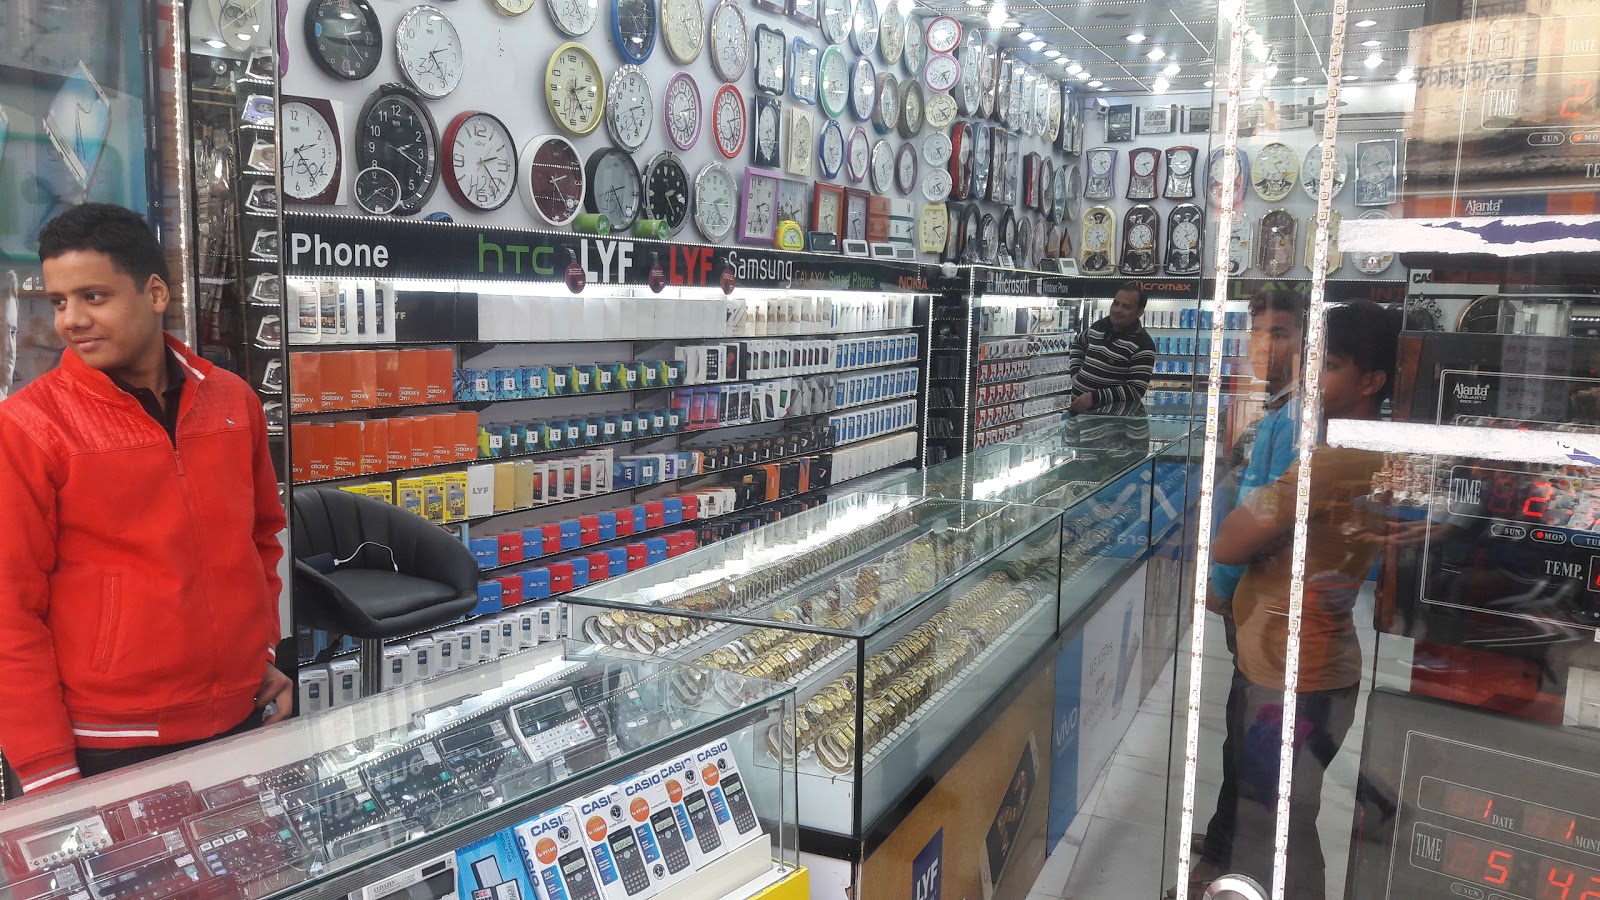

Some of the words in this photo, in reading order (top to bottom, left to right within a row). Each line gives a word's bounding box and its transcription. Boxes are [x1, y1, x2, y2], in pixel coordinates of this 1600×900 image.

[1572, 40, 1597, 53] DATE
[391, 104, 401, 116] 12
[1488, 89, 1518, 116] TIME
[290, 110, 299, 121] 12
[378, 110, 388, 122] 11
[408, 115, 413, 126] 1
[317, 130, 322, 141] 2
[369, 125, 381, 136] 10
[416, 131, 422, 142] 2
[472, 121, 488, 138] 12
[1541, 134, 1559, 143] SUN
[368, 142, 375, 153] 9
[418, 149, 424, 159] 3
[416, 165, 422, 176] 4
[1584, 163, 1600, 179] TE
[295, 182, 301, 192] 6
[408, 180, 415, 190] 5
[1465, 199, 1501, 215] Ajanta
[581, 237, 634, 284] LYF
[670, 246, 714, 286] LYF
[728, 250, 793, 289] Samsung
[852, 272, 876, 289] Phone
[899, 275, 929, 291] NOKIA
[995, 273, 1031, 295] Microsoft
[1452, 382, 1490, 400] Ajanta
[472, 486, 489, 495] LYF
[1453, 478, 1482, 505] TIME
[1504, 527, 1522, 536] SUN
[1544, 532, 1564, 542] MON
[1545, 559, 1584, 580] TEMP.
[1056, 706, 1078, 746] vivo
[697, 742, 728, 762] CASIO
[625, 774, 662, 798] CASIO
[530, 814, 567, 837] CASI
[1492, 814, 1515, 830] DATE
[1575, 835, 1600, 852] MONT
[1415, 832, 1443, 862] TIME
[517, 835, 540, 887] CASIO
[916, 857, 939, 900] LYF
[1462, 887, 1481, 898] SUN
